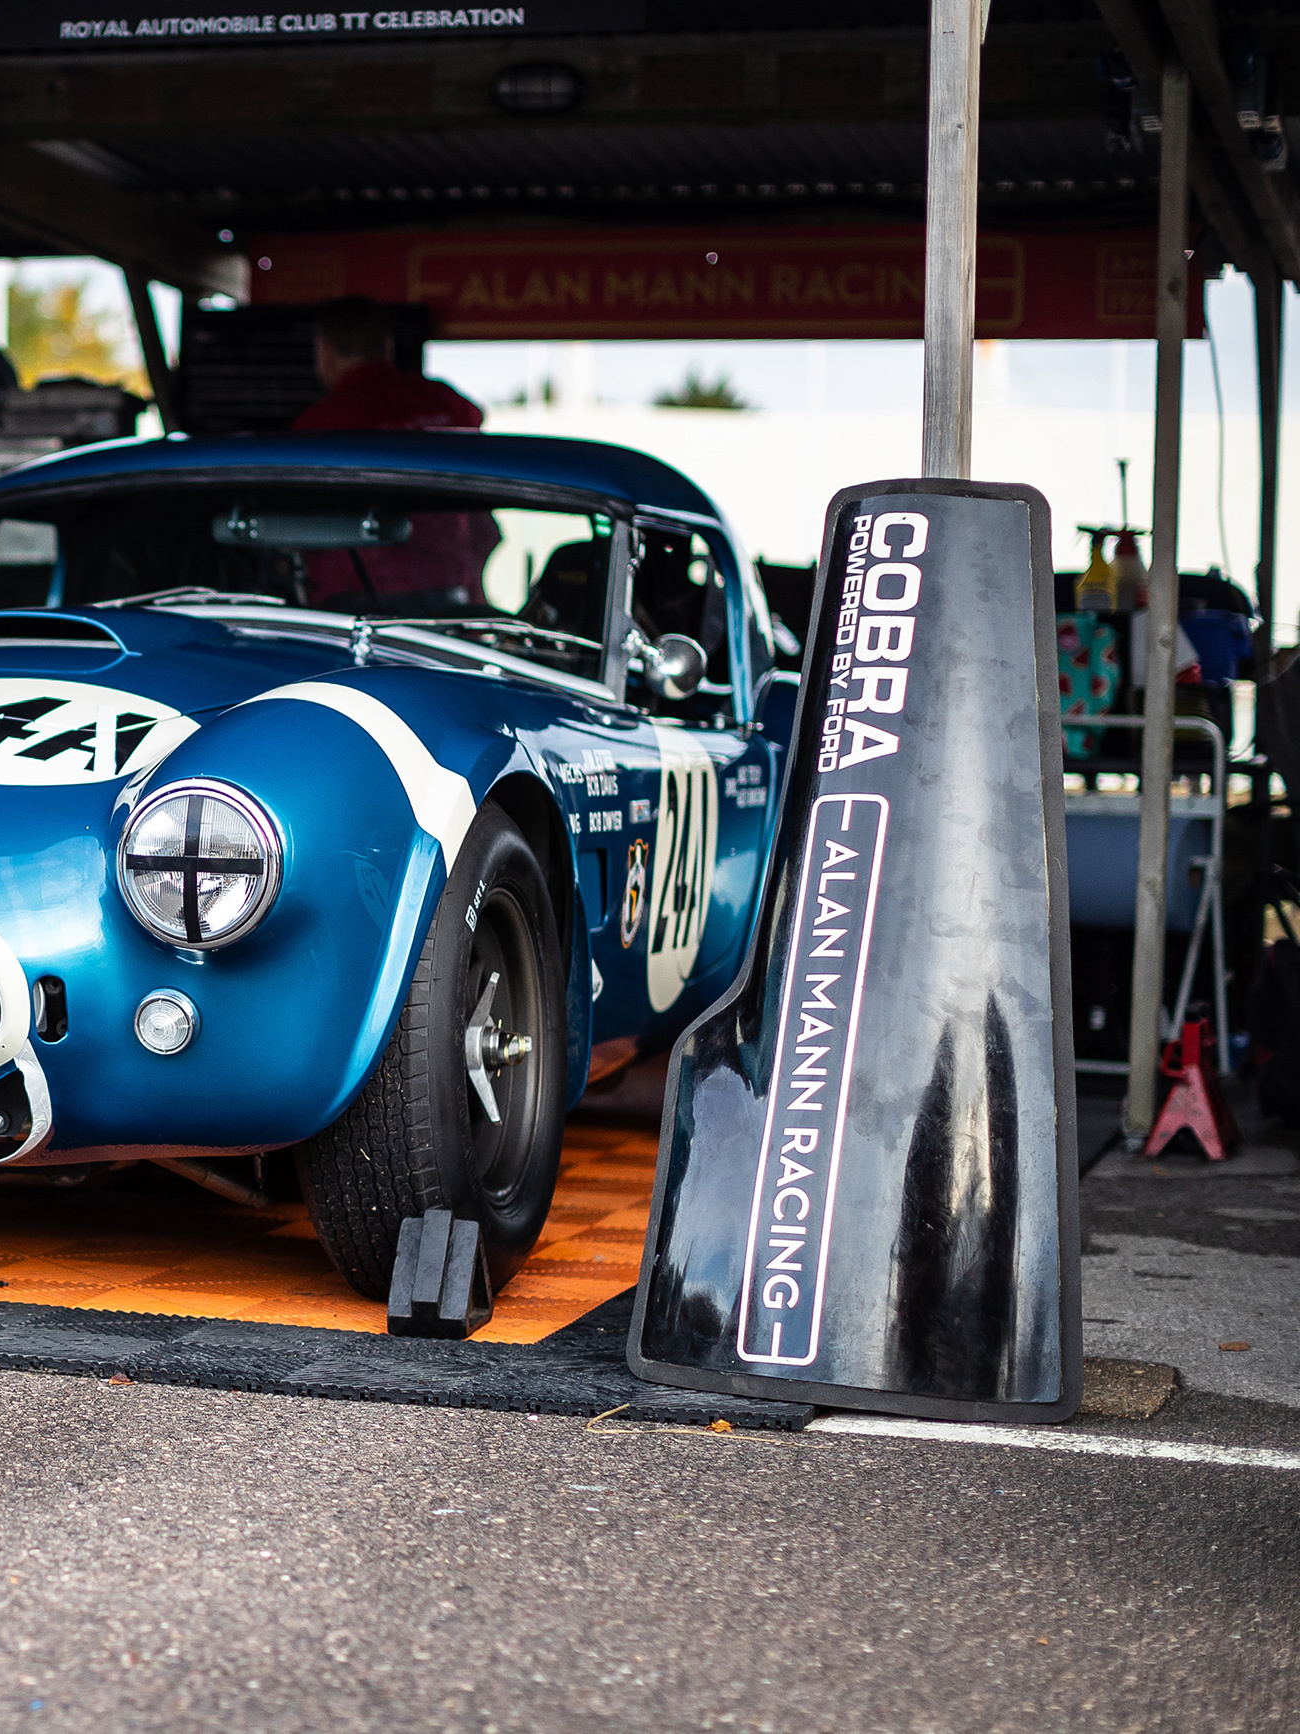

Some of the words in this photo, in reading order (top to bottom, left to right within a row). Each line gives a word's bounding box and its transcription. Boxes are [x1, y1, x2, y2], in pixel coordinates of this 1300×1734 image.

[59, 20, 132, 39] ROYAL
[134, 15, 276, 37] AUTOMOBILE
[279, 13, 338, 32] CLUB
[340, 12, 371, 30] TT
[373, 7, 525, 29] CELEBRATION
[456, 267, 590, 311] ALAN
[602, 264, 755, 308] MANN
[769, 260, 925, 306] RACIN
[835, 514, 873, 646] POWERED
[830, 652, 852, 689] BY
[838, 512, 929, 770] COBRA
[817, 698, 847, 773] FORD
[586, 774, 600, 797] BOB
[589, 811, 602, 833] BOB
[809, 839, 859, 959] ALAN
[790, 973, 842, 1113] MANN
[763, 1127, 819, 1311] RACING
